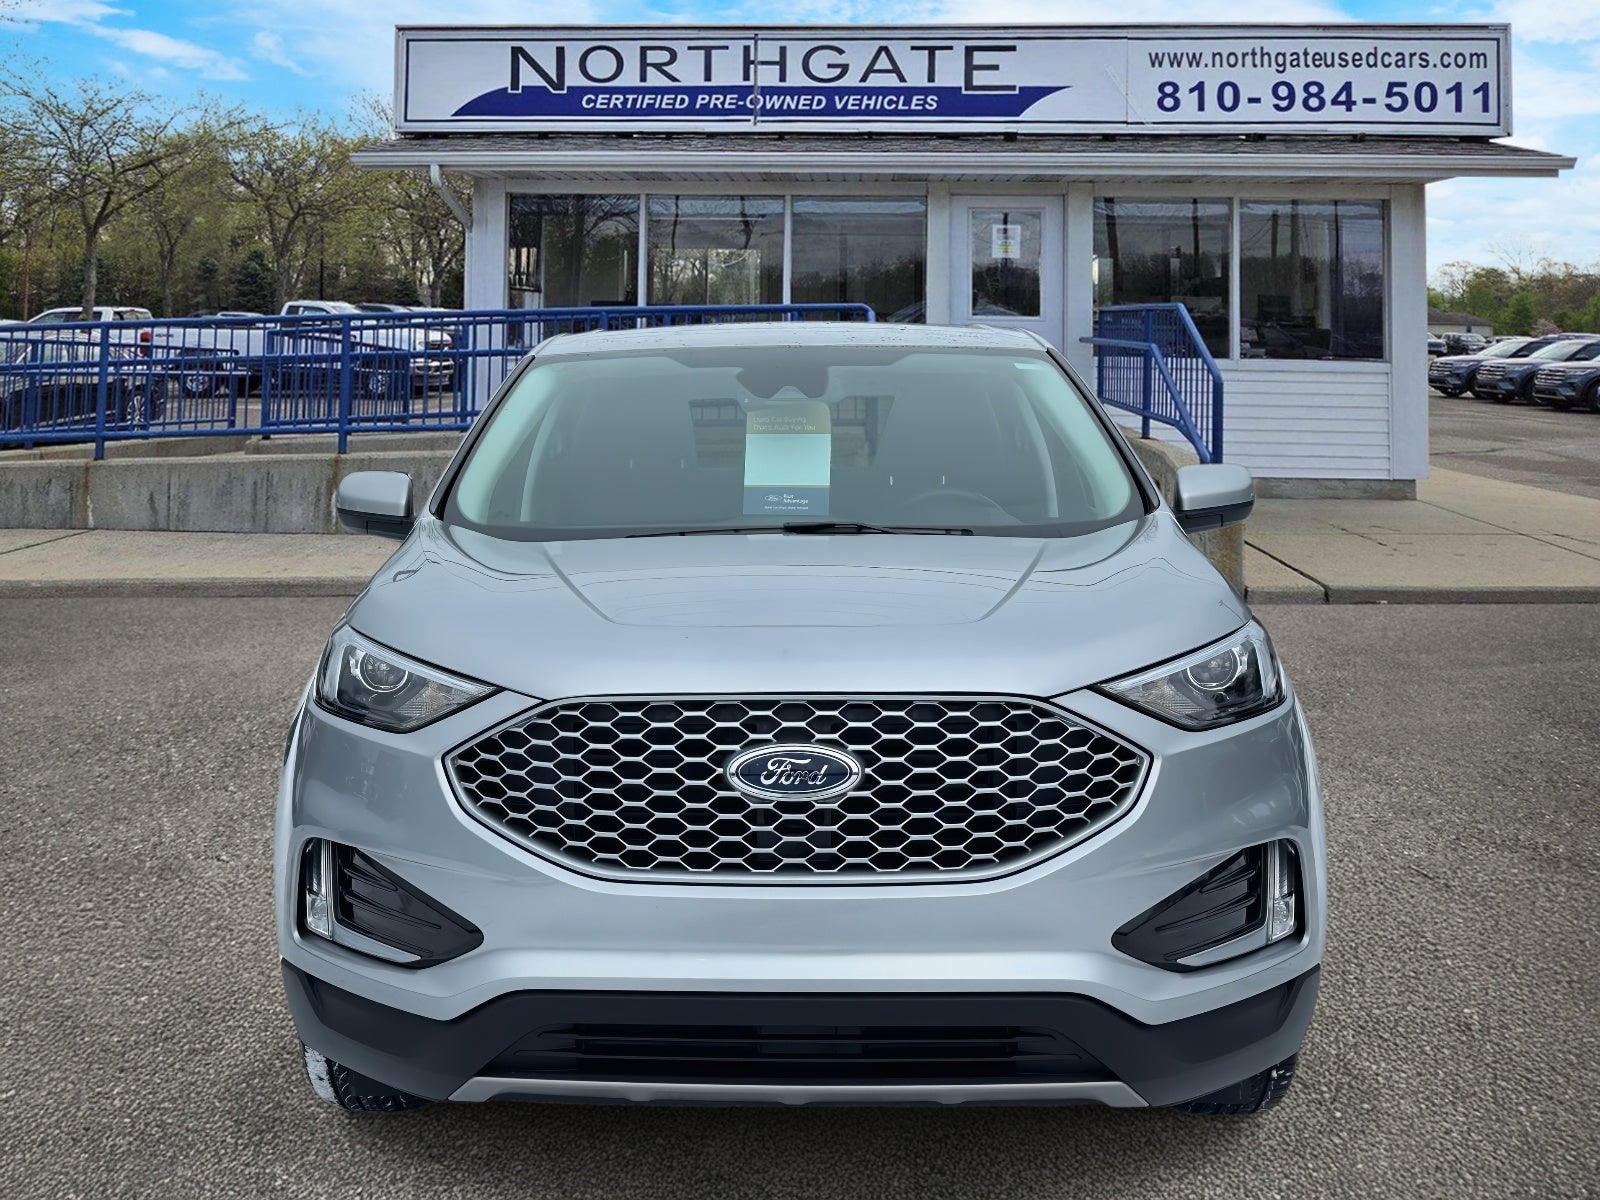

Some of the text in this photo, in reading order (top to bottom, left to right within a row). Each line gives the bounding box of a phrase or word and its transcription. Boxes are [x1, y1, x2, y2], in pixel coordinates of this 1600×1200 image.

[510, 44, 1018, 93] NORTHGATE
[1148, 47, 1488, 73] www.northgateusedcars.com
[581, 93, 939, 111] CERTIFIED PRE-OWNED VEHICLES
[1156, 80, 1491, 113] 810-984-5011
[760, 757, 829, 785] Ford
